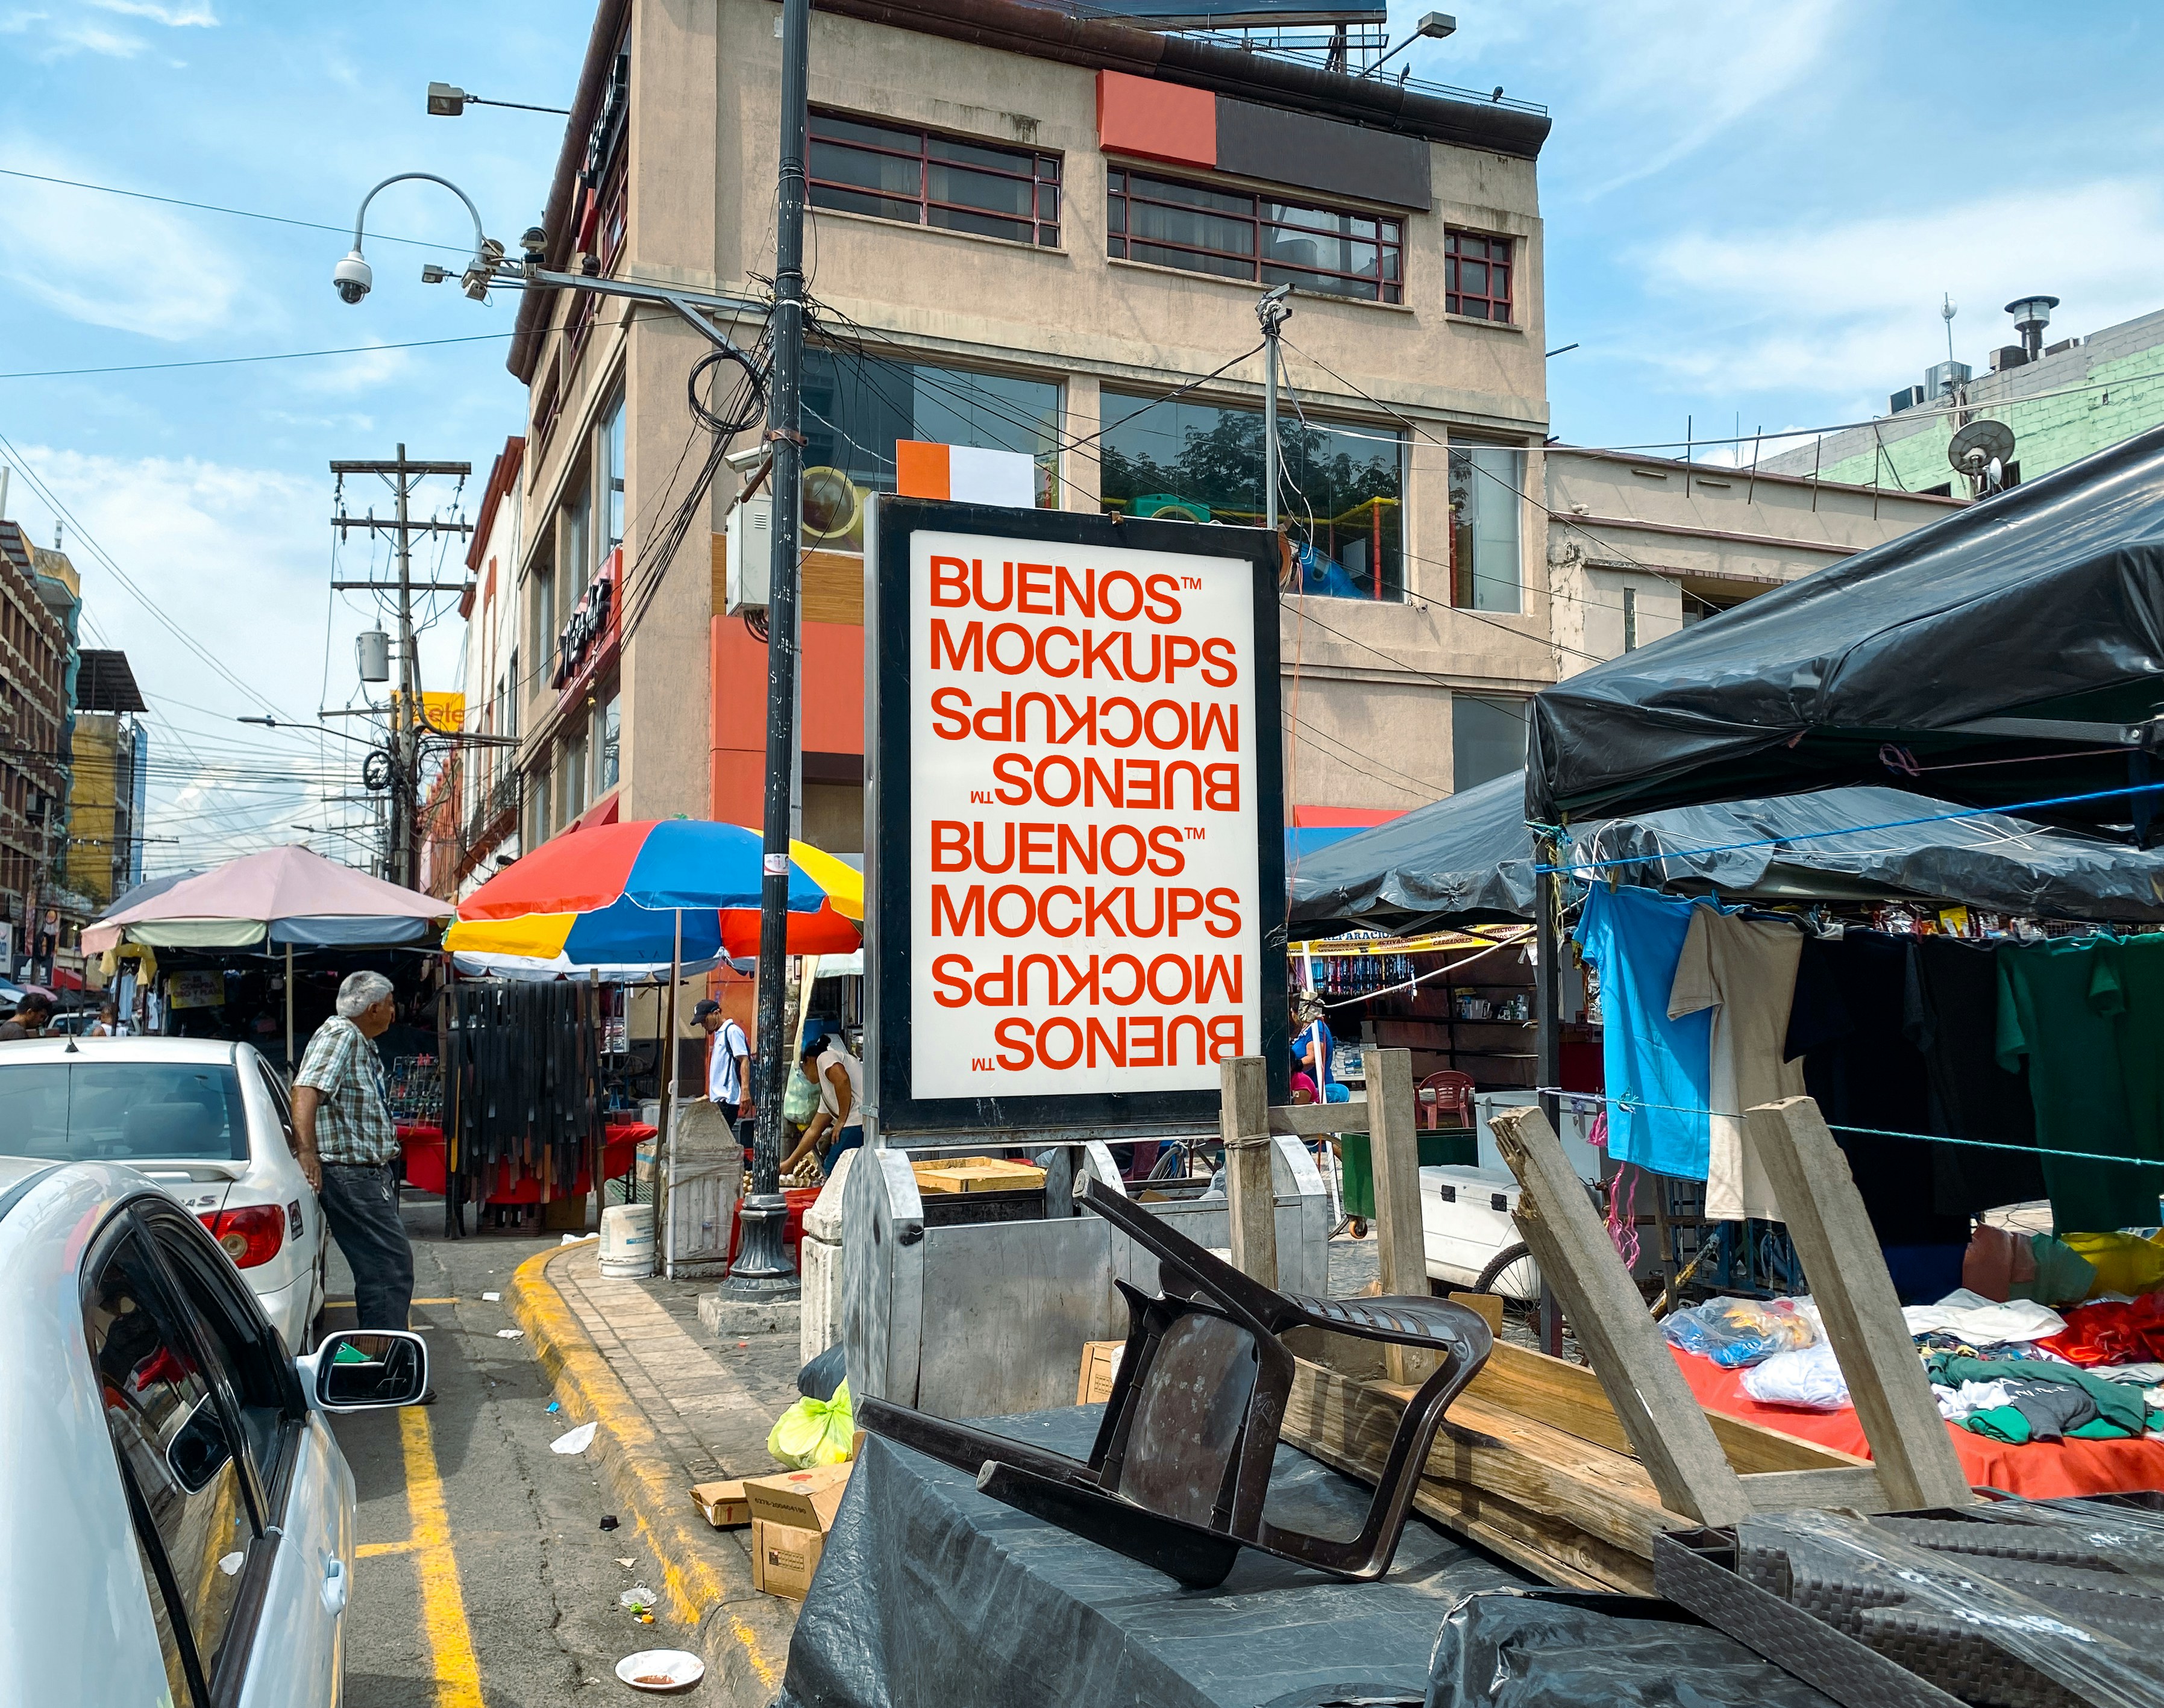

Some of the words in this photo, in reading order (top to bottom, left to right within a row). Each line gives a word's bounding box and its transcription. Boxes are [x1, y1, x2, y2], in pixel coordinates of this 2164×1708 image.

[930, 618, 1238, 688] MOCKUPS
[930, 687, 1239, 752] MOCKUPS
[931, 884, 1242, 939] MOCKUPS
[932, 953, 1243, 1008] MOCKUPS
